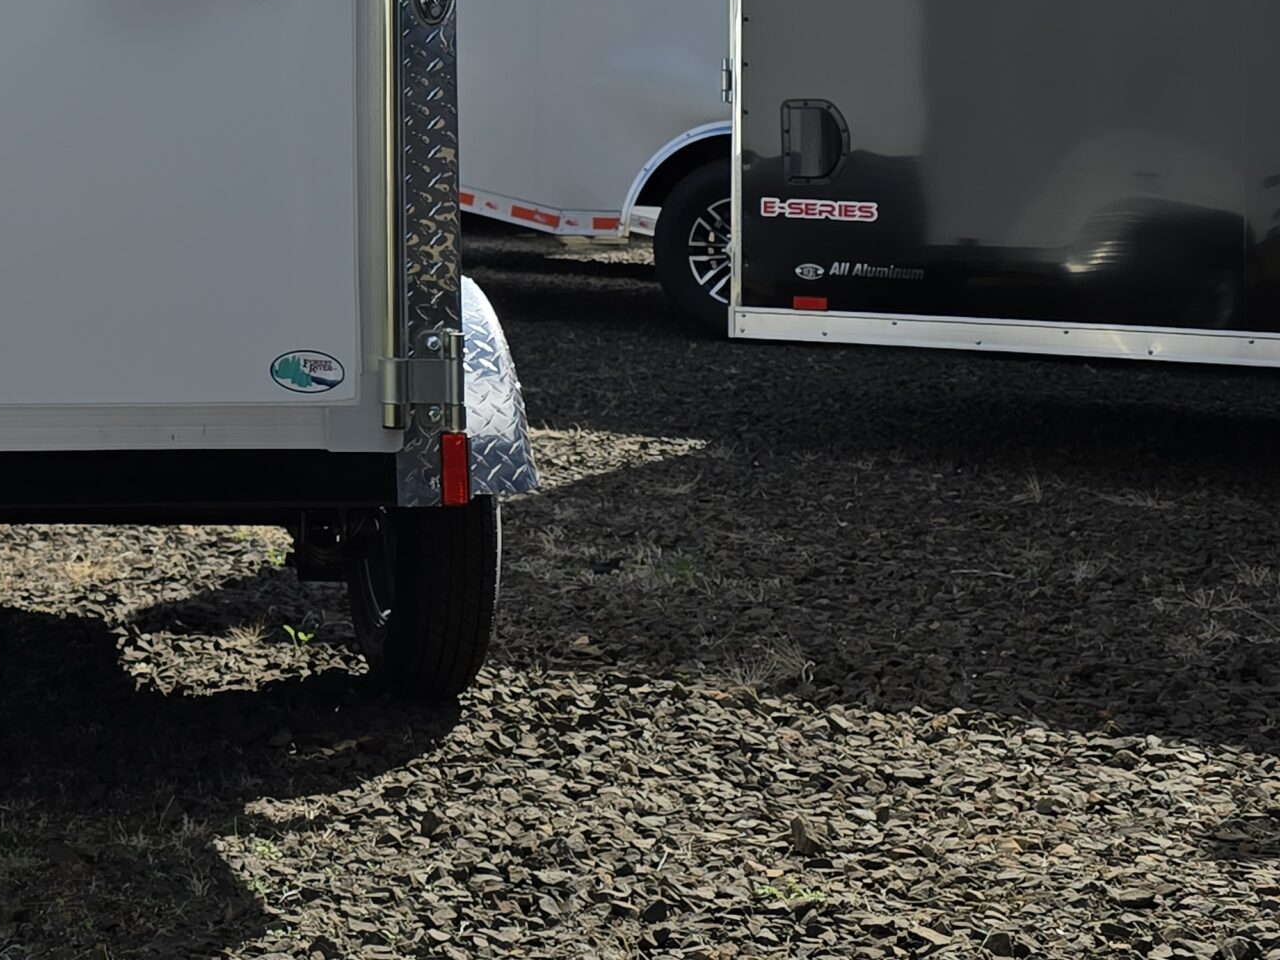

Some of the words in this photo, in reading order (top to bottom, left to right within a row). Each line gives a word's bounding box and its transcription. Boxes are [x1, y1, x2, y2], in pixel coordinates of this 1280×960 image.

[762, 200, 876, 219] E-SERIES
[829, 262, 850, 276] All
[852, 263, 925, 280] Aluminum
